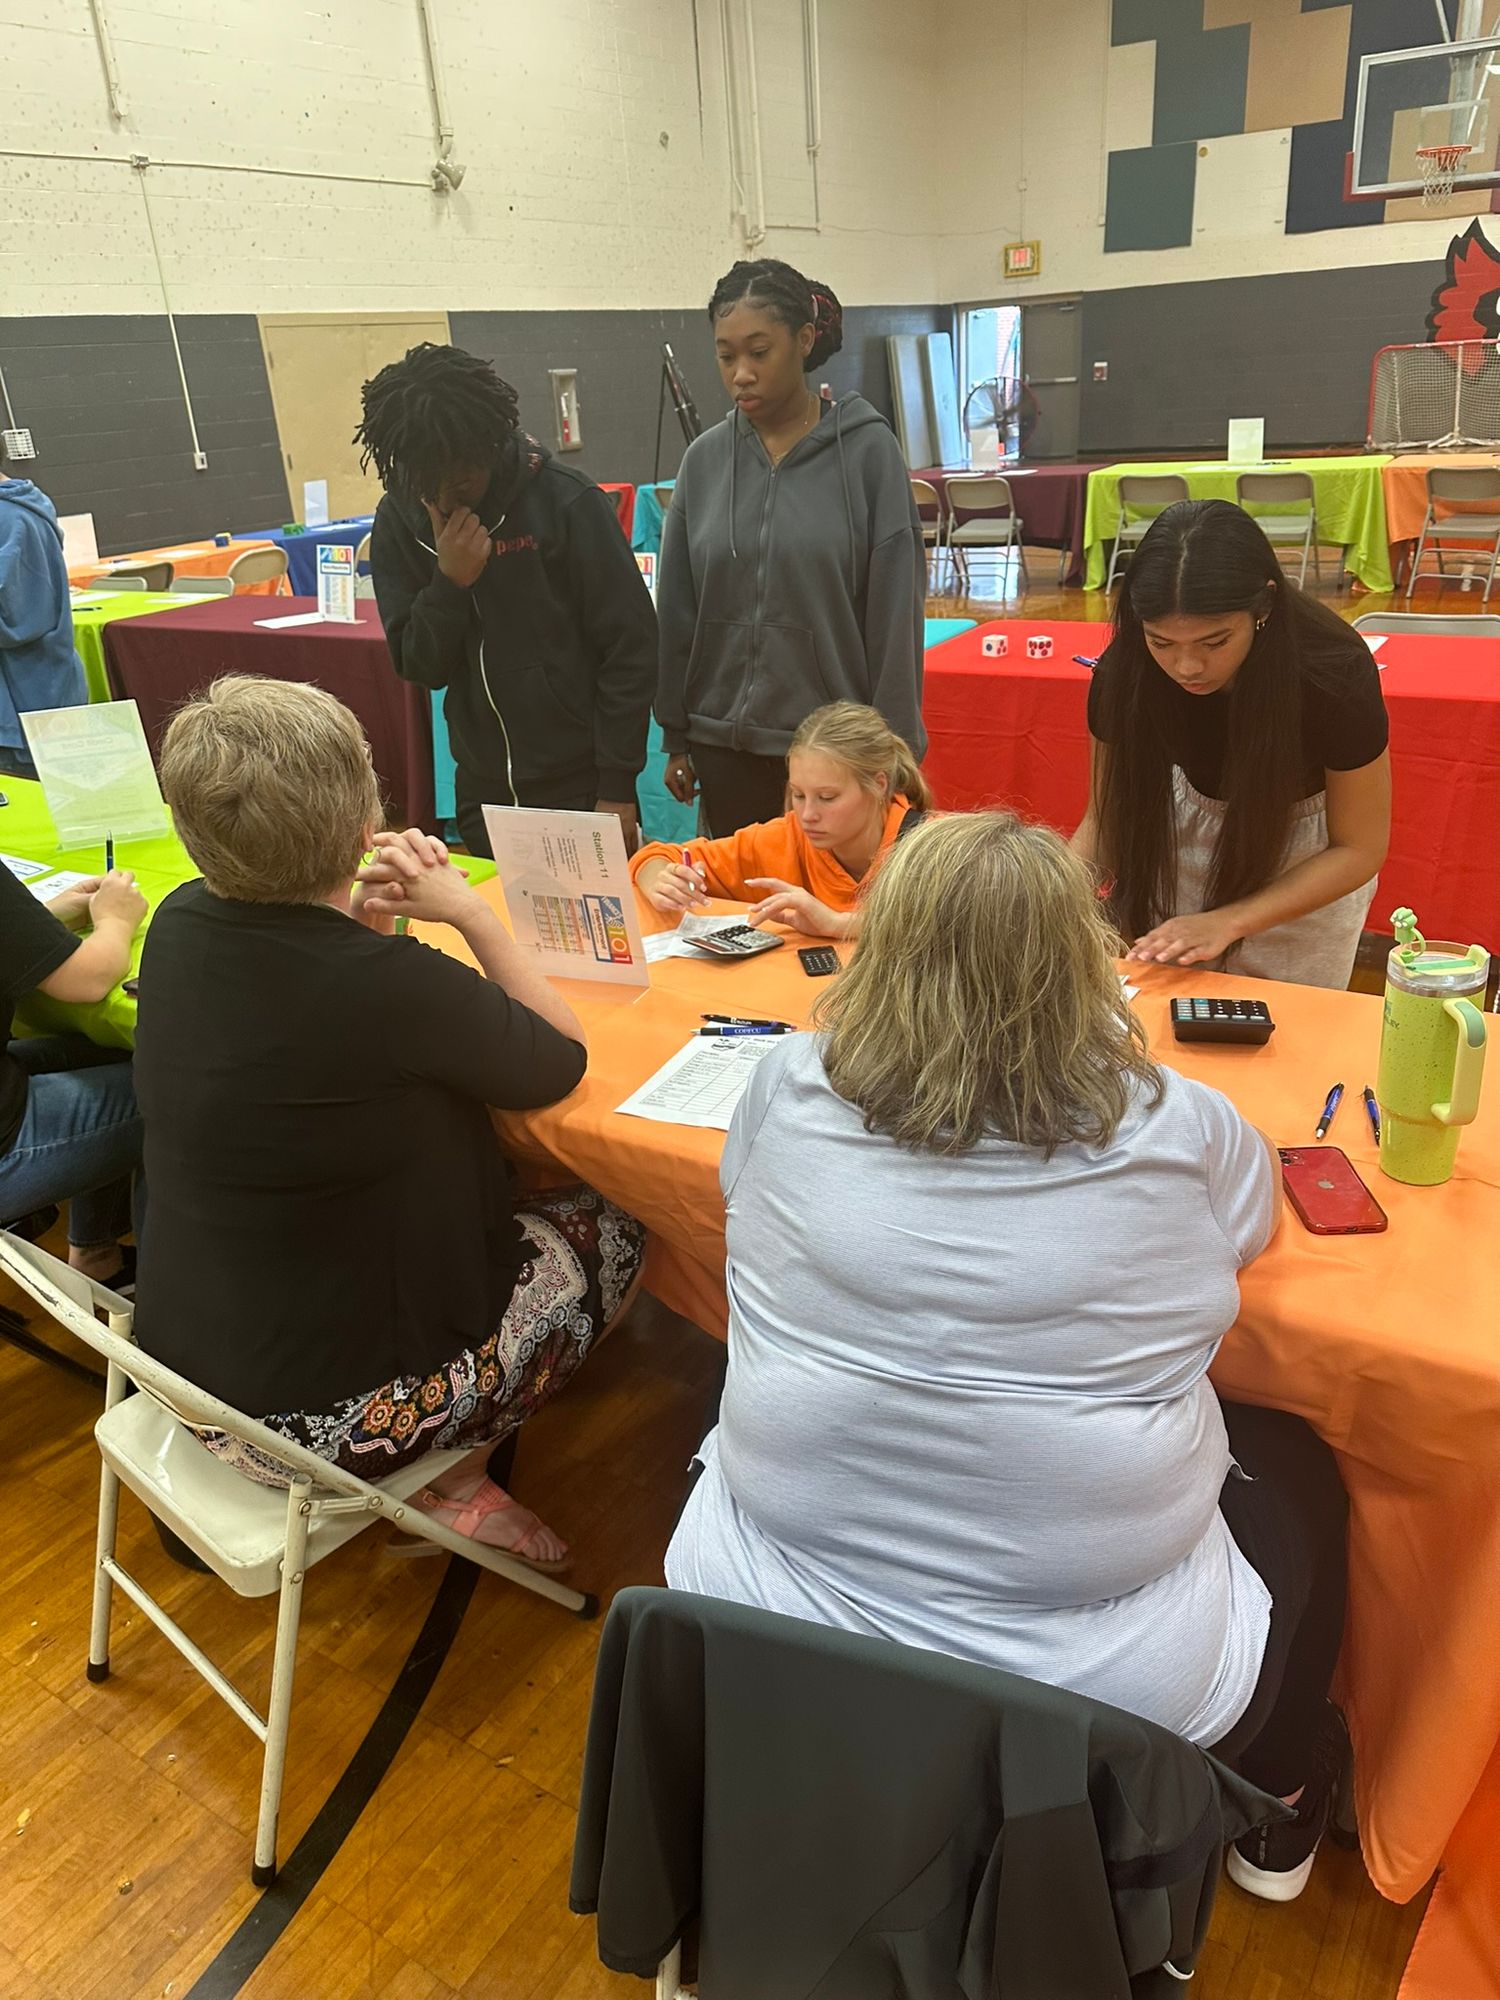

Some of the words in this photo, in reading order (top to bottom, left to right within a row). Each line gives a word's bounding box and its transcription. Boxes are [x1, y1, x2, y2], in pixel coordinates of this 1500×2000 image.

[592, 831, 605, 866] Station
[600, 868, 609, 879] 11
[593, 908, 607, 950] Entertainment
[609, 929, 630, 960] 101
